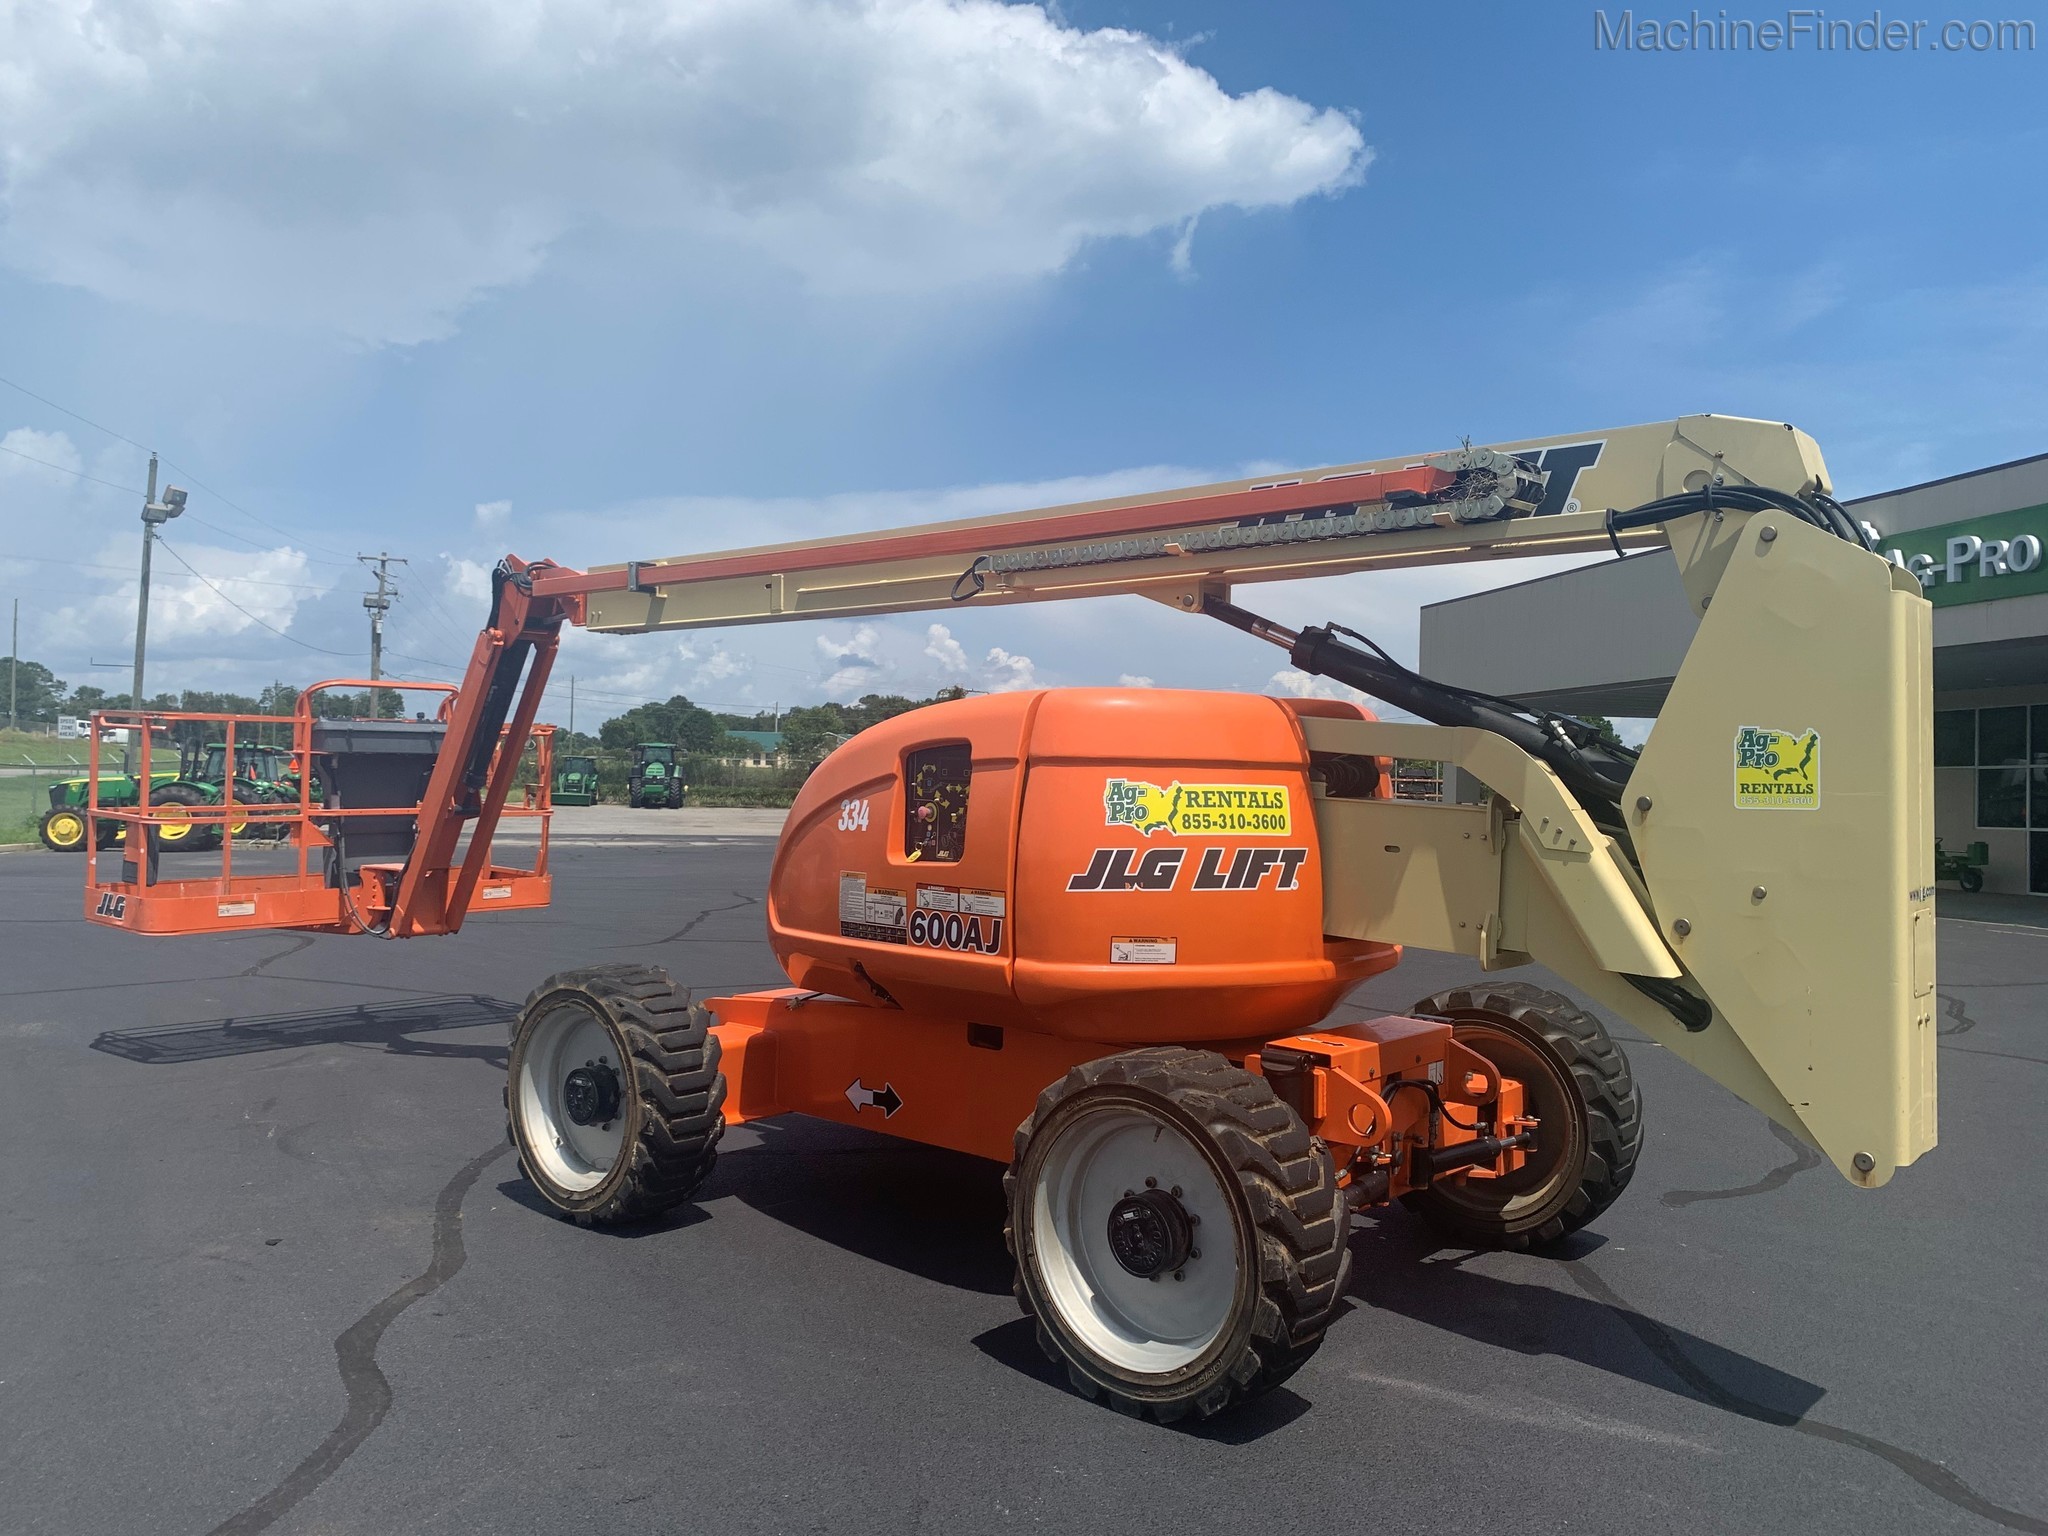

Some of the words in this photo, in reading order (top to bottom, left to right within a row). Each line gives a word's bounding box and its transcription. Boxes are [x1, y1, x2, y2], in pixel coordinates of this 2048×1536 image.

[1739, 729, 1778, 751] Ag-
[1738, 748, 1779, 768] Pro
[1108, 782, 1146, 806] Ag-
[1740, 783, 1814, 795] RENTALS
[1185, 790, 1284, 810] RENTALS
[1740, 796, 1814, 805] 855-310-3600
[838, 799, 869, 831] 334
[1109, 802, 1148, 822] Pro
[1182, 813, 1286, 830] 855-310-3600
[1066, 848, 1187, 892] JLG
[1191, 847, 1308, 891] LIFT
[877, 888, 899, 897] WARNING
[96, 892, 125, 920] JLG
[909, 909, 1003, 956] 600AJ
